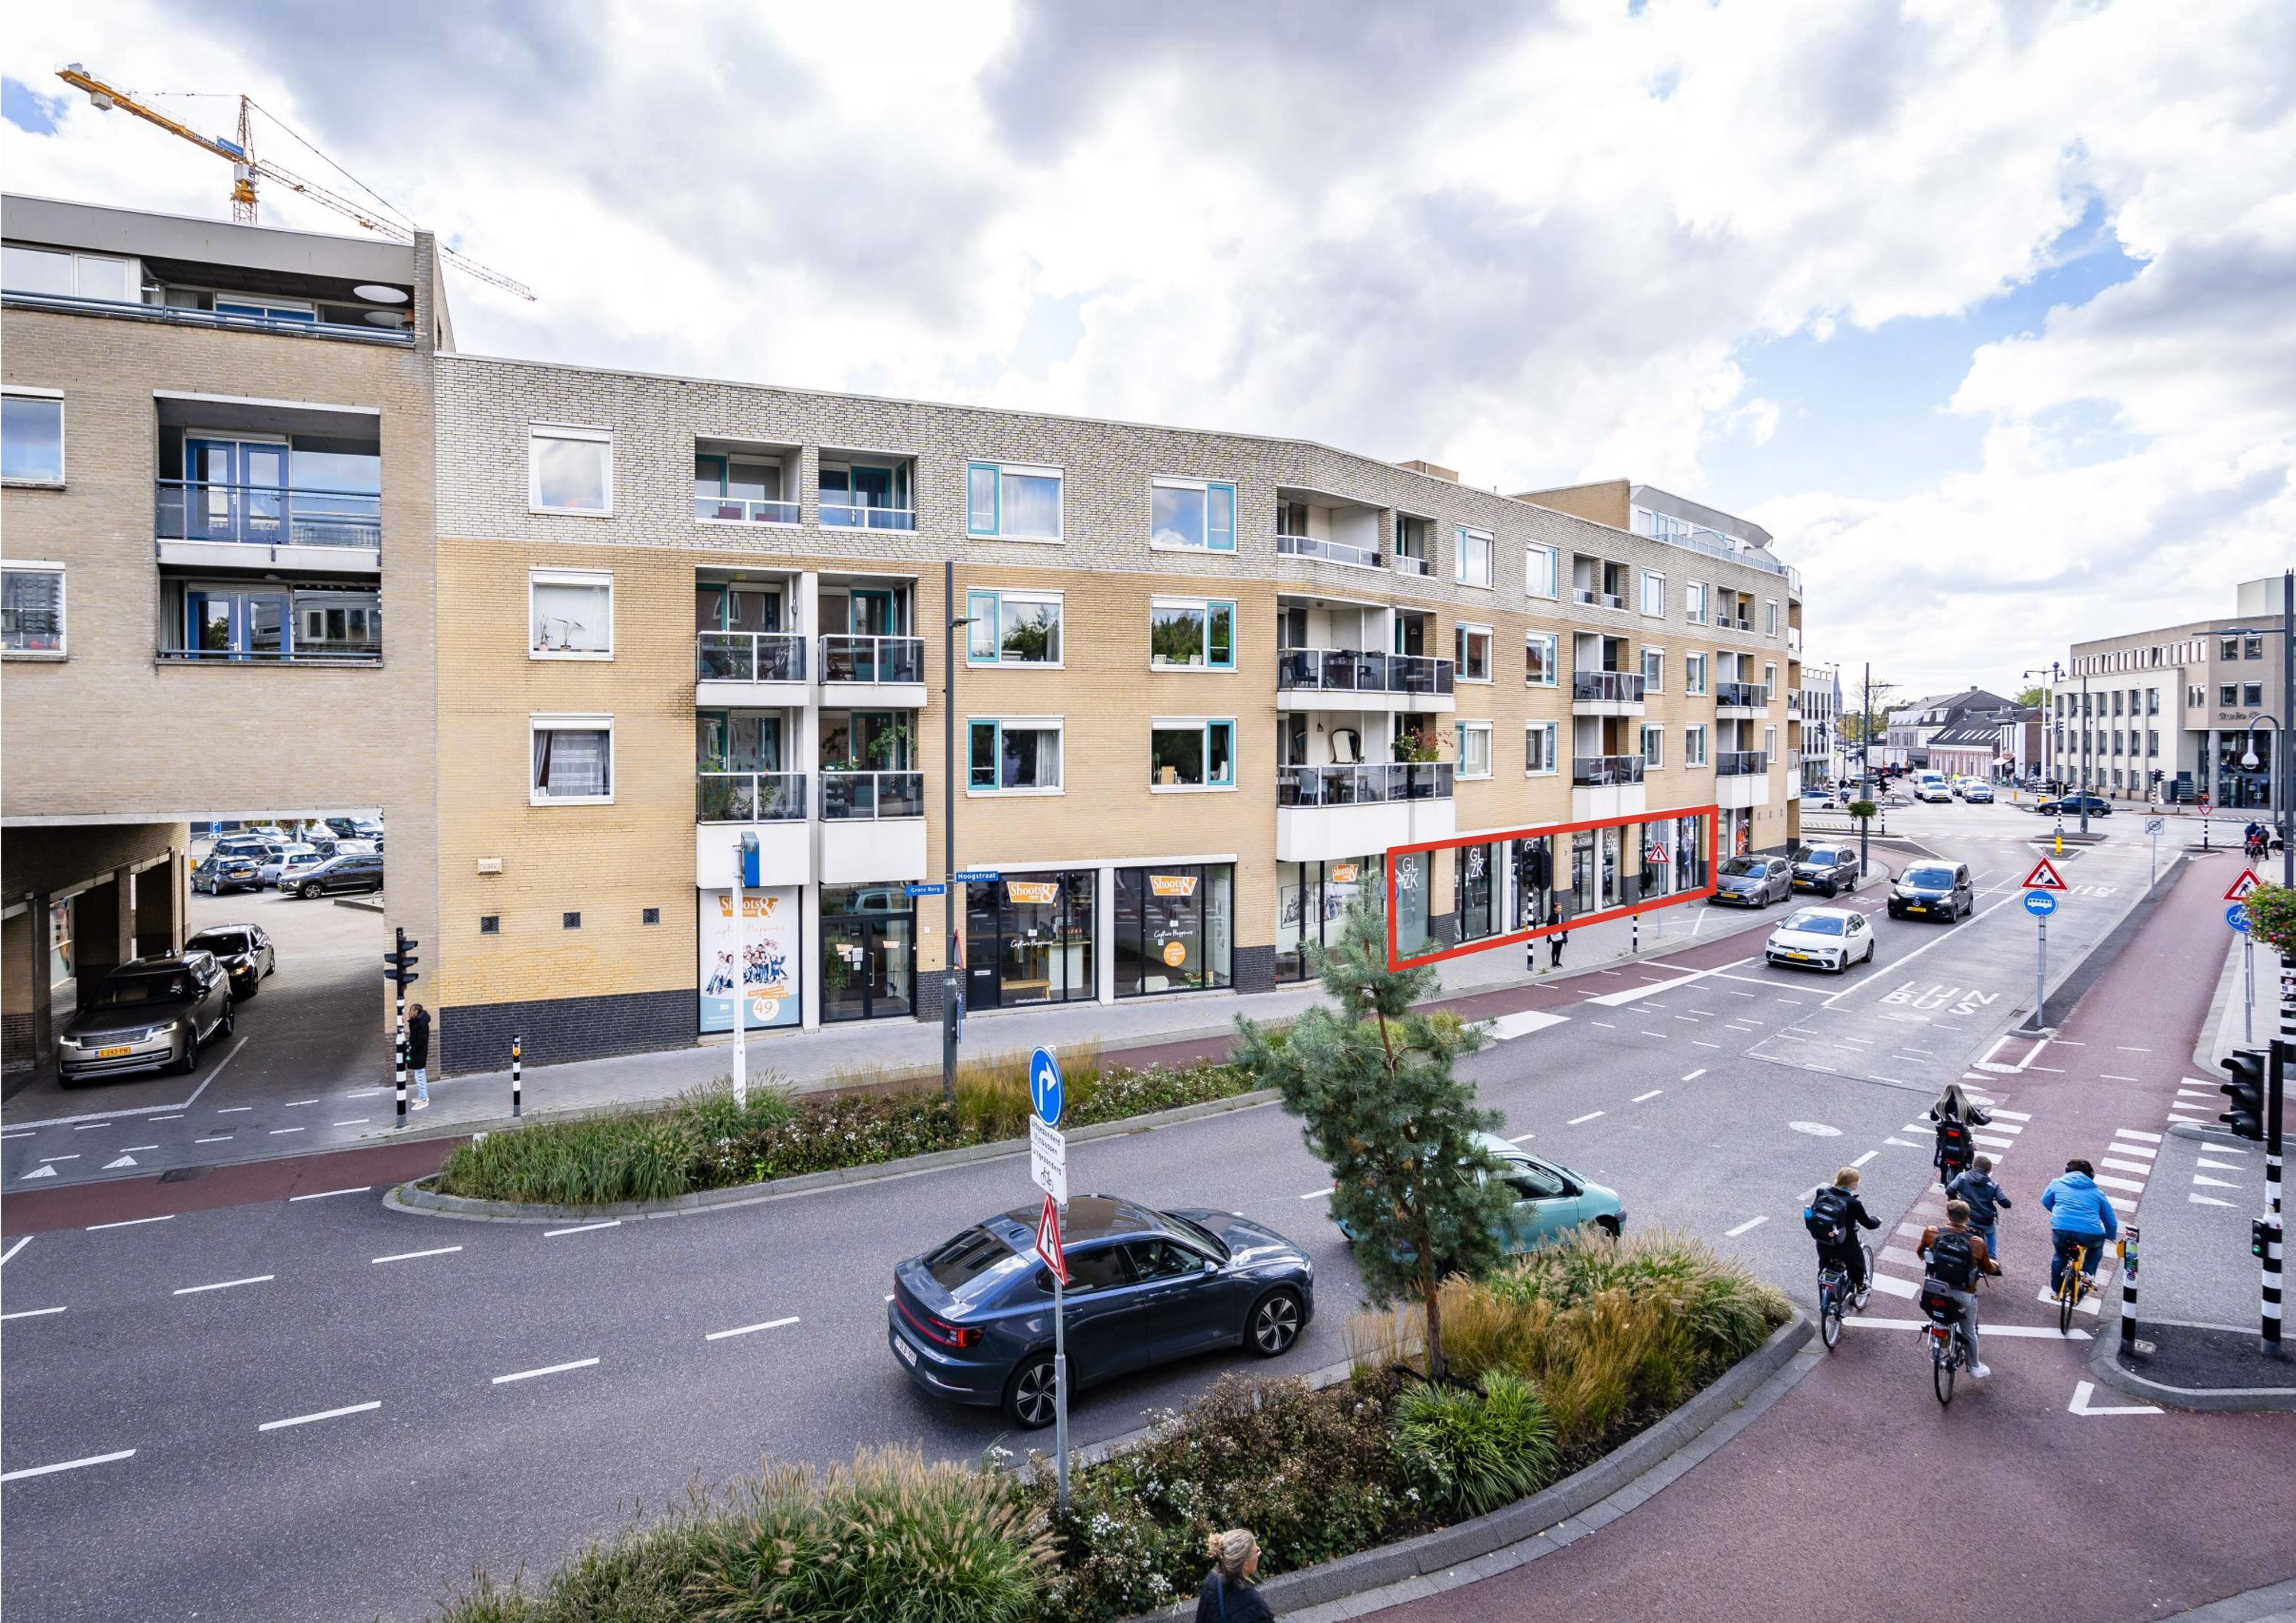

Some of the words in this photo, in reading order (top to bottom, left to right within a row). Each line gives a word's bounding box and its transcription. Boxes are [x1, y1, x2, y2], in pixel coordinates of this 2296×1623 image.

[1470, 848, 1484, 862] GL
[1403, 857, 1419, 872] GL
[1470, 862, 1484, 878] ZK
[957, 872, 996, 881] Hoogstraat
[1403, 873, 1418, 889] ZK
[1877, 991, 1981, 1015] BUS
